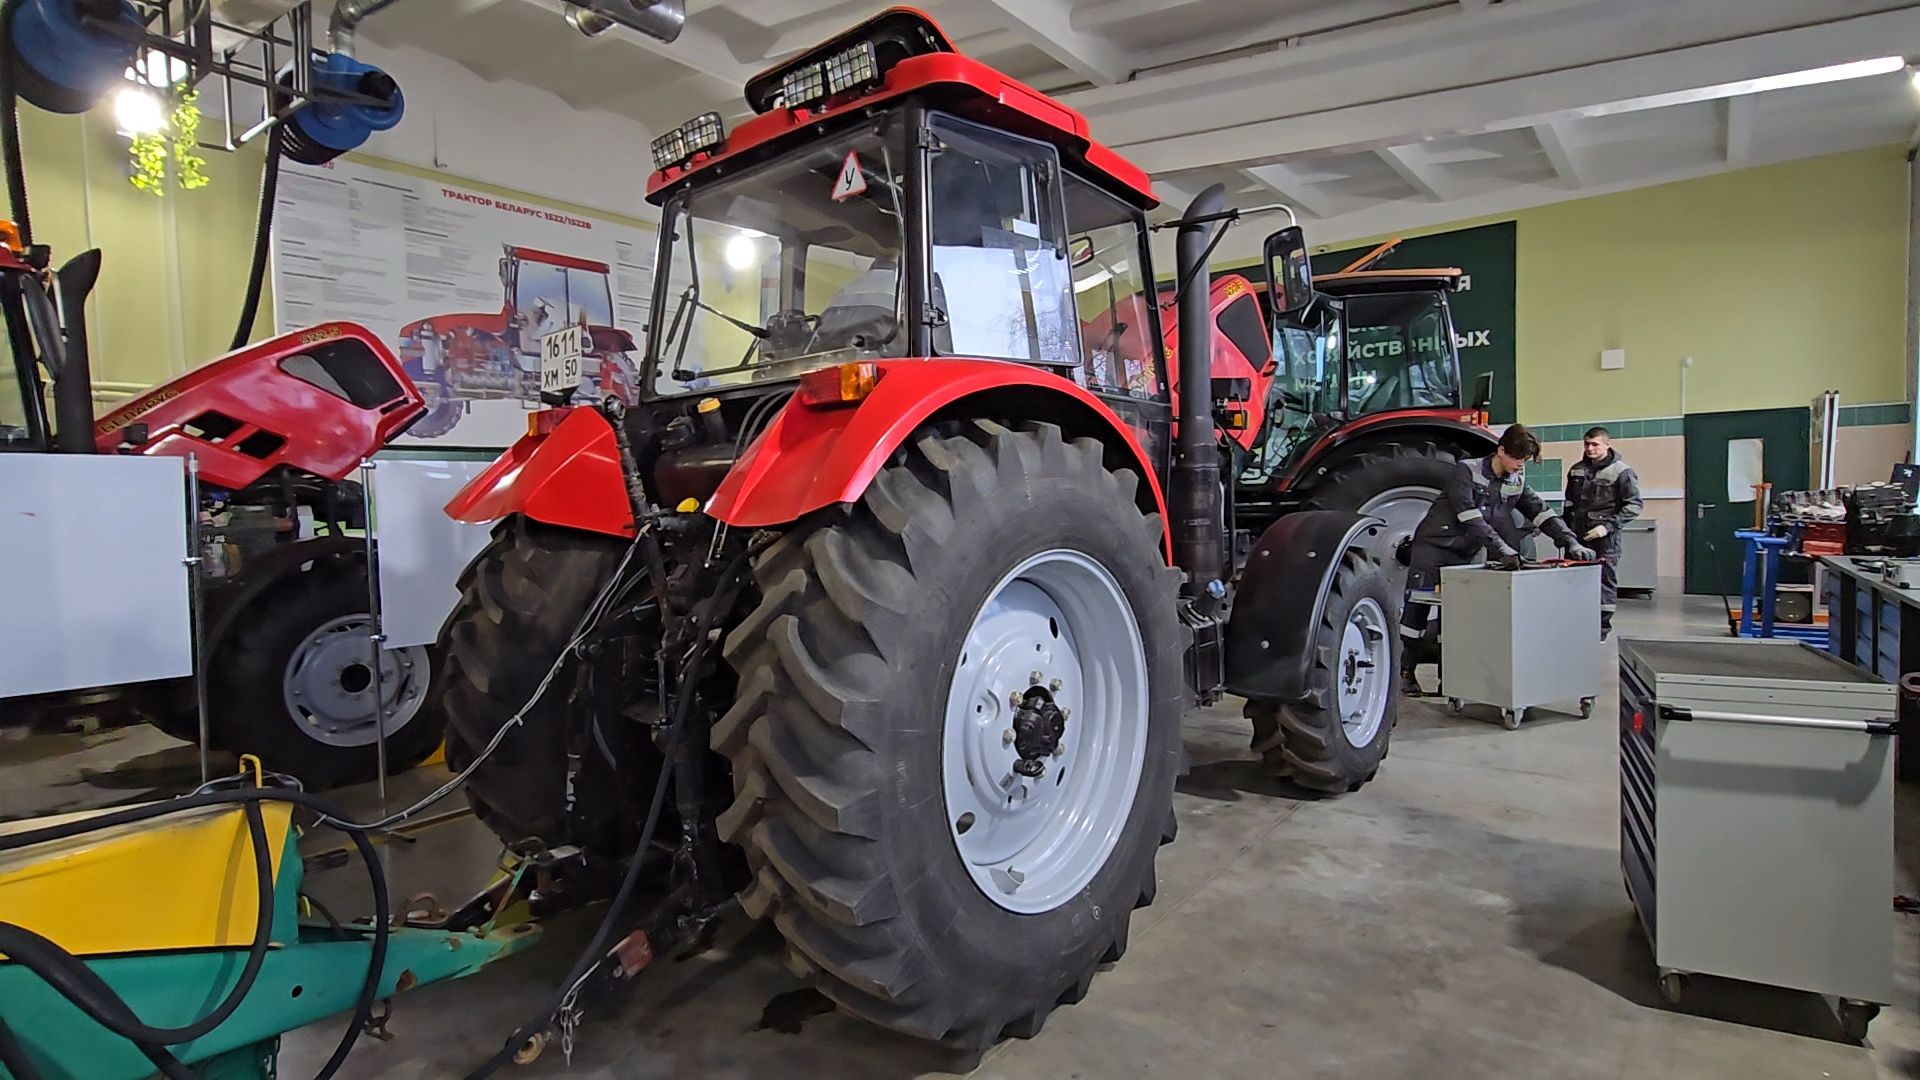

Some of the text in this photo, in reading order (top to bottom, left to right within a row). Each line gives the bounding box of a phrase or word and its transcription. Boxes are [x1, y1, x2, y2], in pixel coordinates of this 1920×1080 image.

[441, 188, 493, 206] ТРАКТОР
[495, 201, 543, 218] БЕЛАРУС
[546, 330, 576, 359] 1611
[543, 368, 559, 388] ХМ
[565, 358, 578, 377] 50
